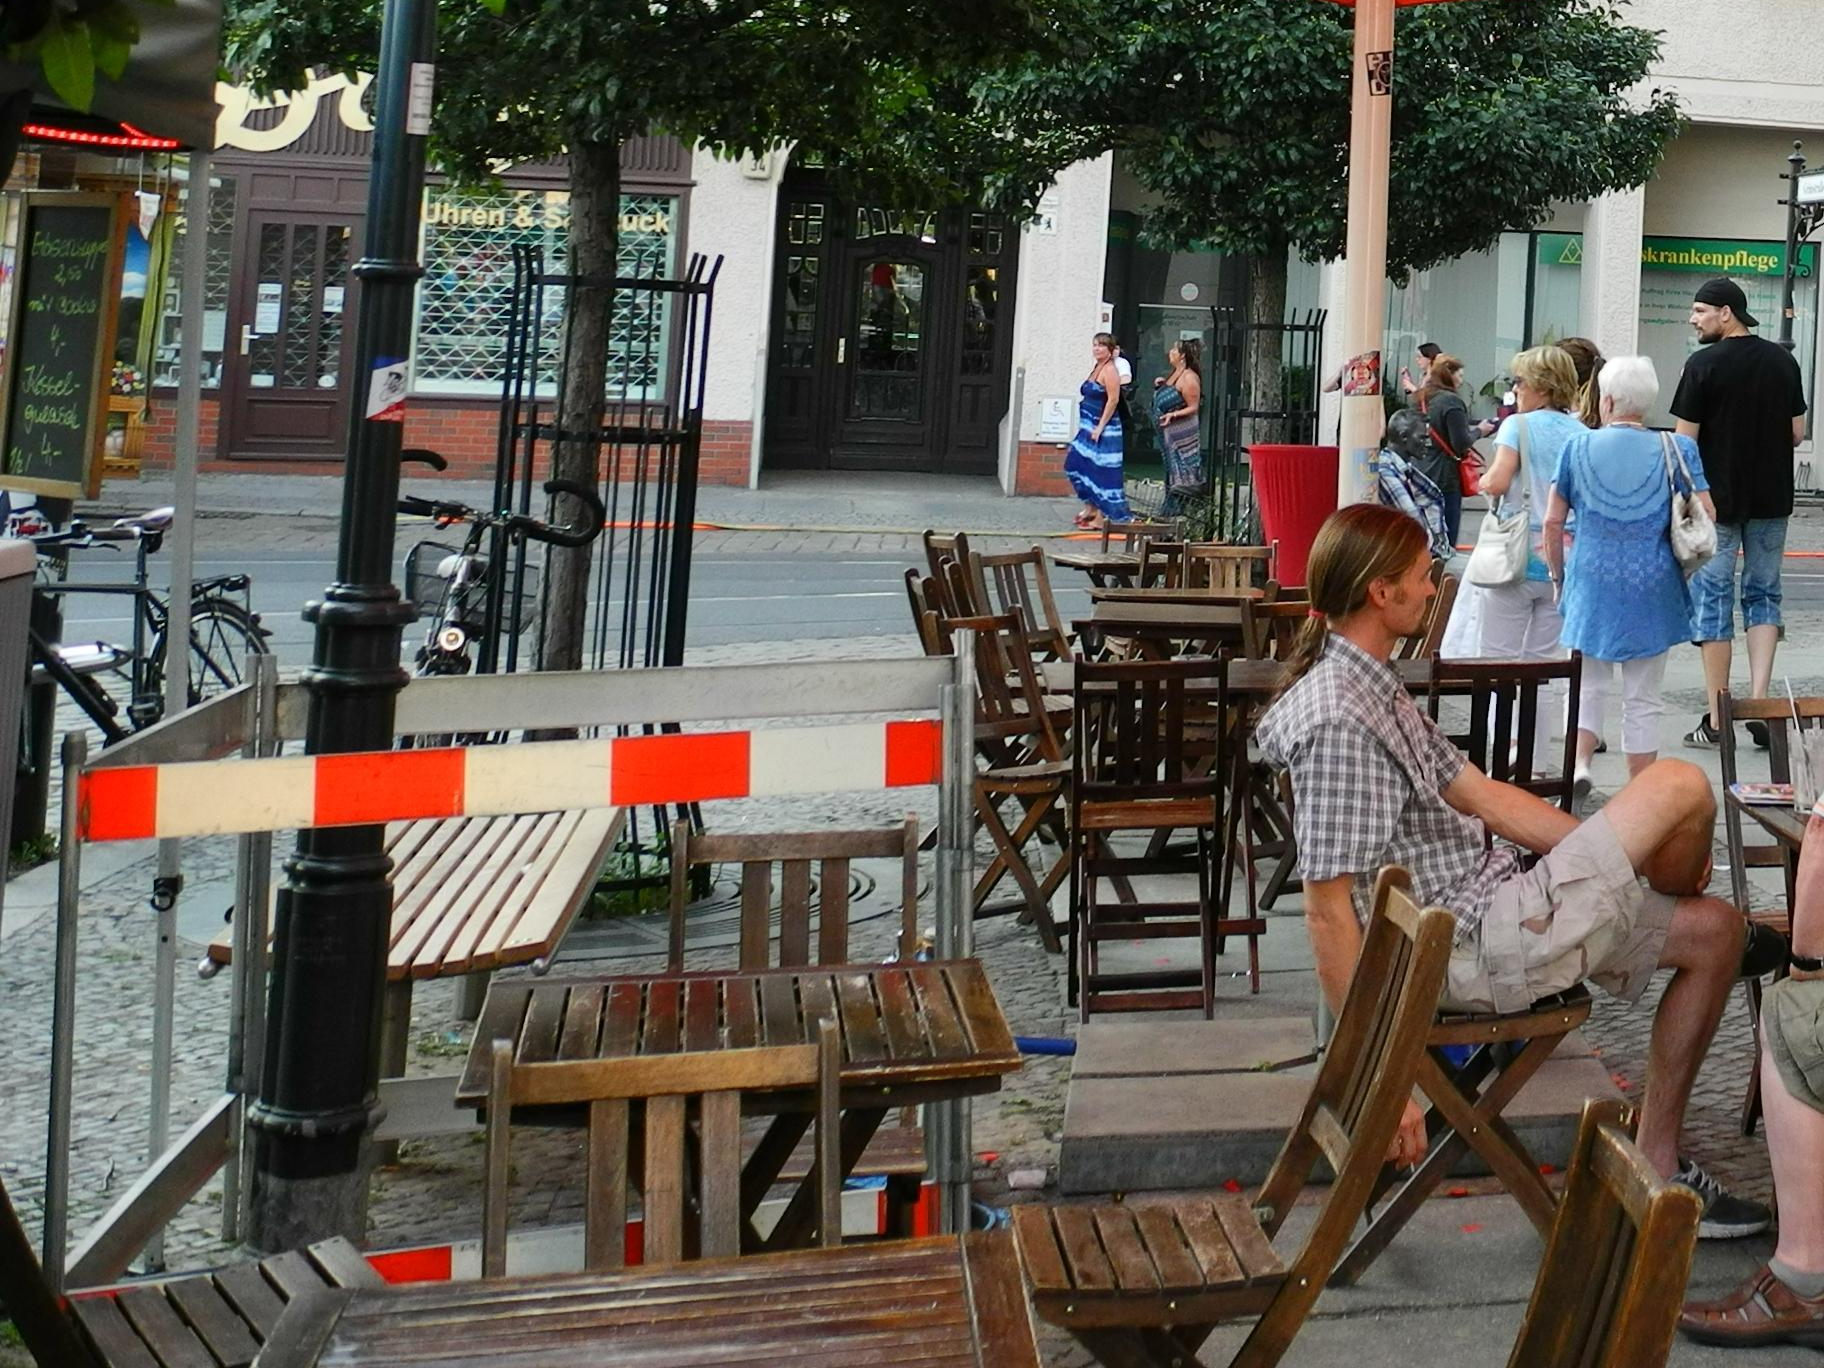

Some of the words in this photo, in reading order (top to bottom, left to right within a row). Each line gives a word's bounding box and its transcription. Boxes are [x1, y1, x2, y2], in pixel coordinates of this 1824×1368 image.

[422, 201, 505, 226] Uhren
[513, 205, 535, 228] &
[543, 206, 671, 233] Suck
